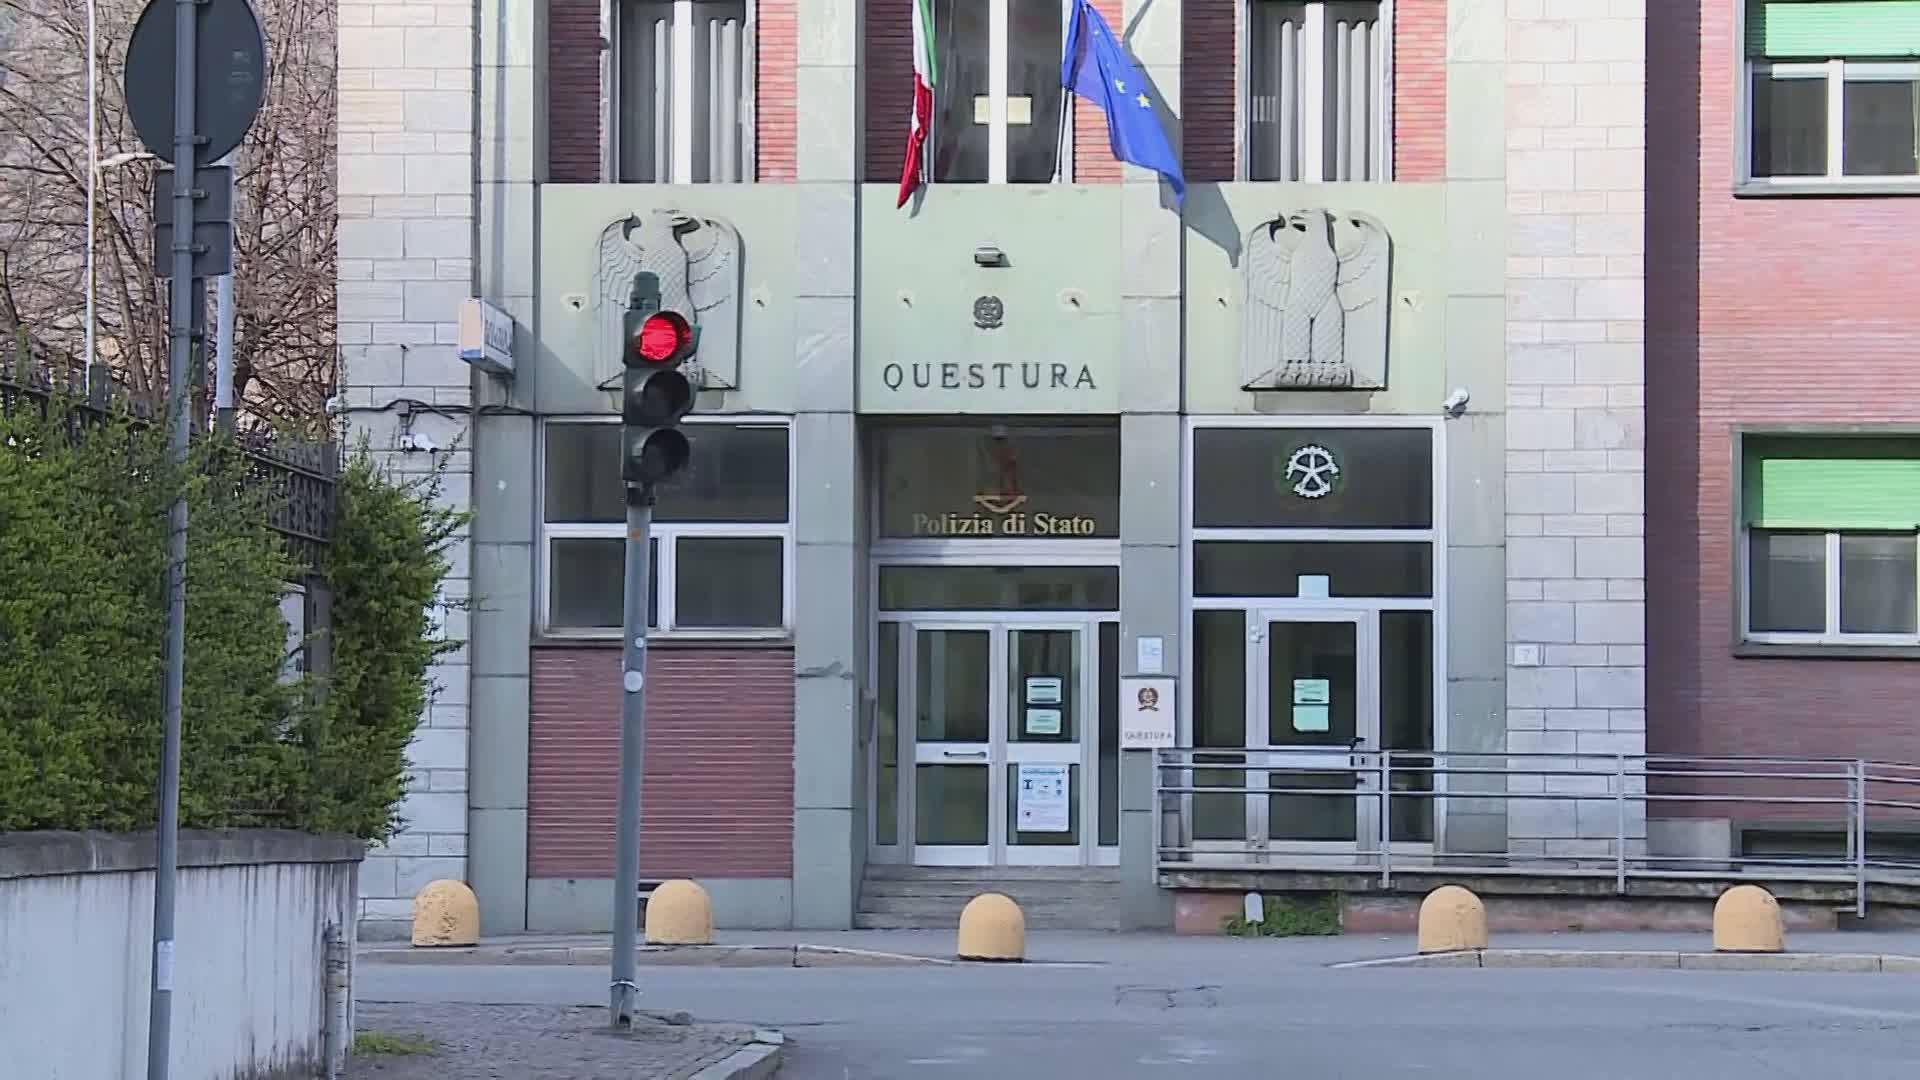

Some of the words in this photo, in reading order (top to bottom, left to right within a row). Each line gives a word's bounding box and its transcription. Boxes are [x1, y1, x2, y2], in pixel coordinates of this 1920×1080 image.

[883, 362, 1097, 392] QUESTURA
[912, 513, 993, 535] Polizia
[1002, 513, 1025, 535] di
[1033, 512, 1096, 535] Stato
